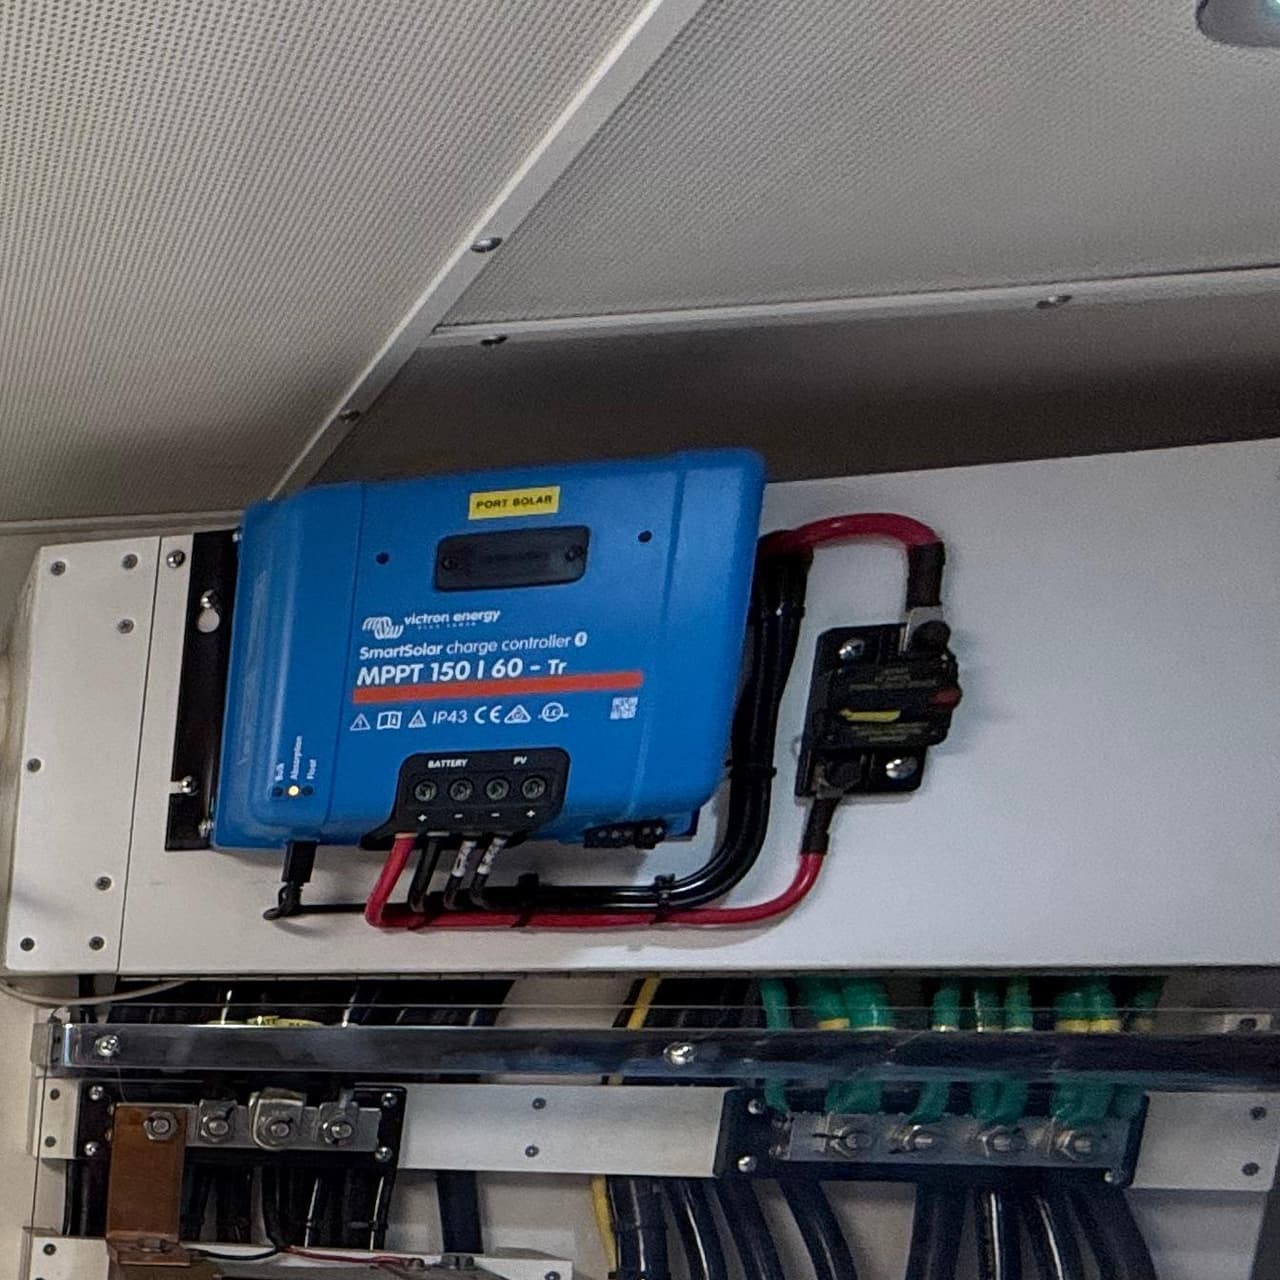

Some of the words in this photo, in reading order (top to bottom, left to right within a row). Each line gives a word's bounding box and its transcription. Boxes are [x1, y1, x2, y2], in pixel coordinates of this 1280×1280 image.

[476, 499, 507, 509] PORT
[404, 613, 449, 625] victron
[453, 610, 500, 622] energy
[359, 642, 444, 660] SmartSolar
[446, 640, 499, 656] charge
[501, 634, 571, 651] controller
[356, 664, 424, 686] MPPT
[430, 660, 471, 682] 150
[491, 658, 523, 679] 60
[548, 659, 567, 676] Tr
[432, 710, 468, 725] IP43
[427, 758, 469, 769] BATTERY
[513, 756, 528, 765] PV
